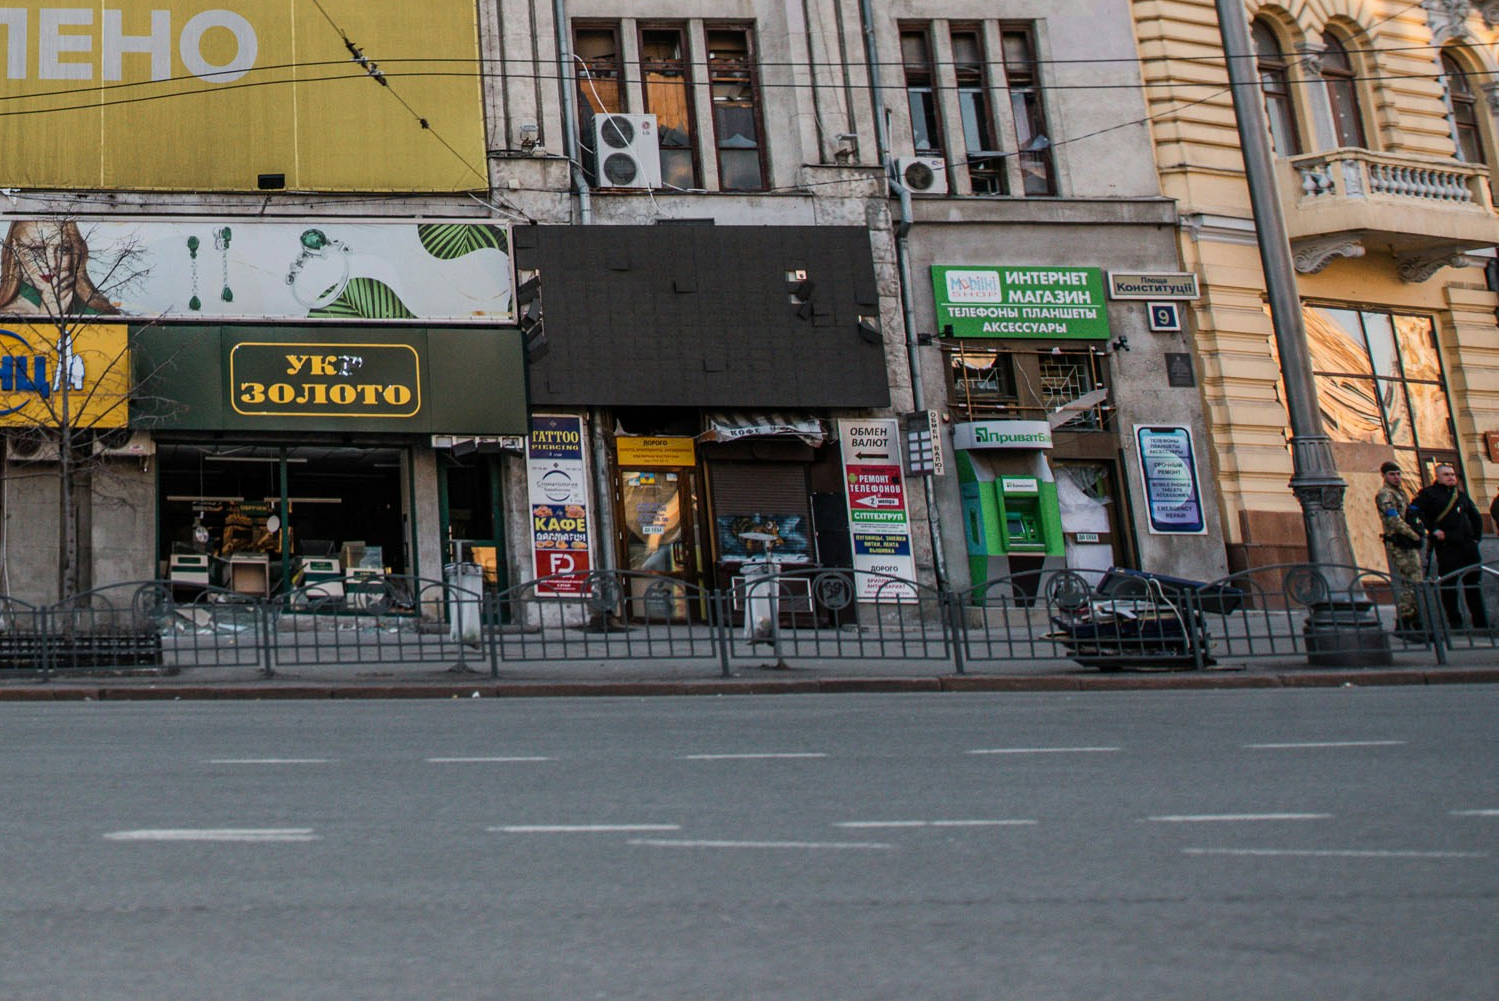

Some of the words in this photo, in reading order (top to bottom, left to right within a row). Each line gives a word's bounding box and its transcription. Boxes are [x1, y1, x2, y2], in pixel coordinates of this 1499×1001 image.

[1005, 271, 1088, 286] ИНТЕРНЕТ
[1140, 276, 1168, 285] Площа
[1116, 282, 1192, 294] Конституції
[1008, 289, 1092, 305] МАГАЗИН
[948, 307, 1019, 318] ТЕЛЕФОНЫ
[1022, 308, 1097, 319] ПЛАНШЕТЫ
[1157, 309, 1170, 325] 9
[982, 321, 1068, 333] АКСЕССУАРЫ
[240, 382, 411, 405] ЗОЛОТО
[532, 430, 580, 444] TATTOO
[849, 427, 888, 437] ОБМЕН
[851, 438, 889, 448] ВАЛЮТ
[858, 475, 889, 483] РЕМОНТ
[849, 484, 901, 493] ТЕЛЕФОНОВ
[534, 517, 586, 532] КАФЕ
